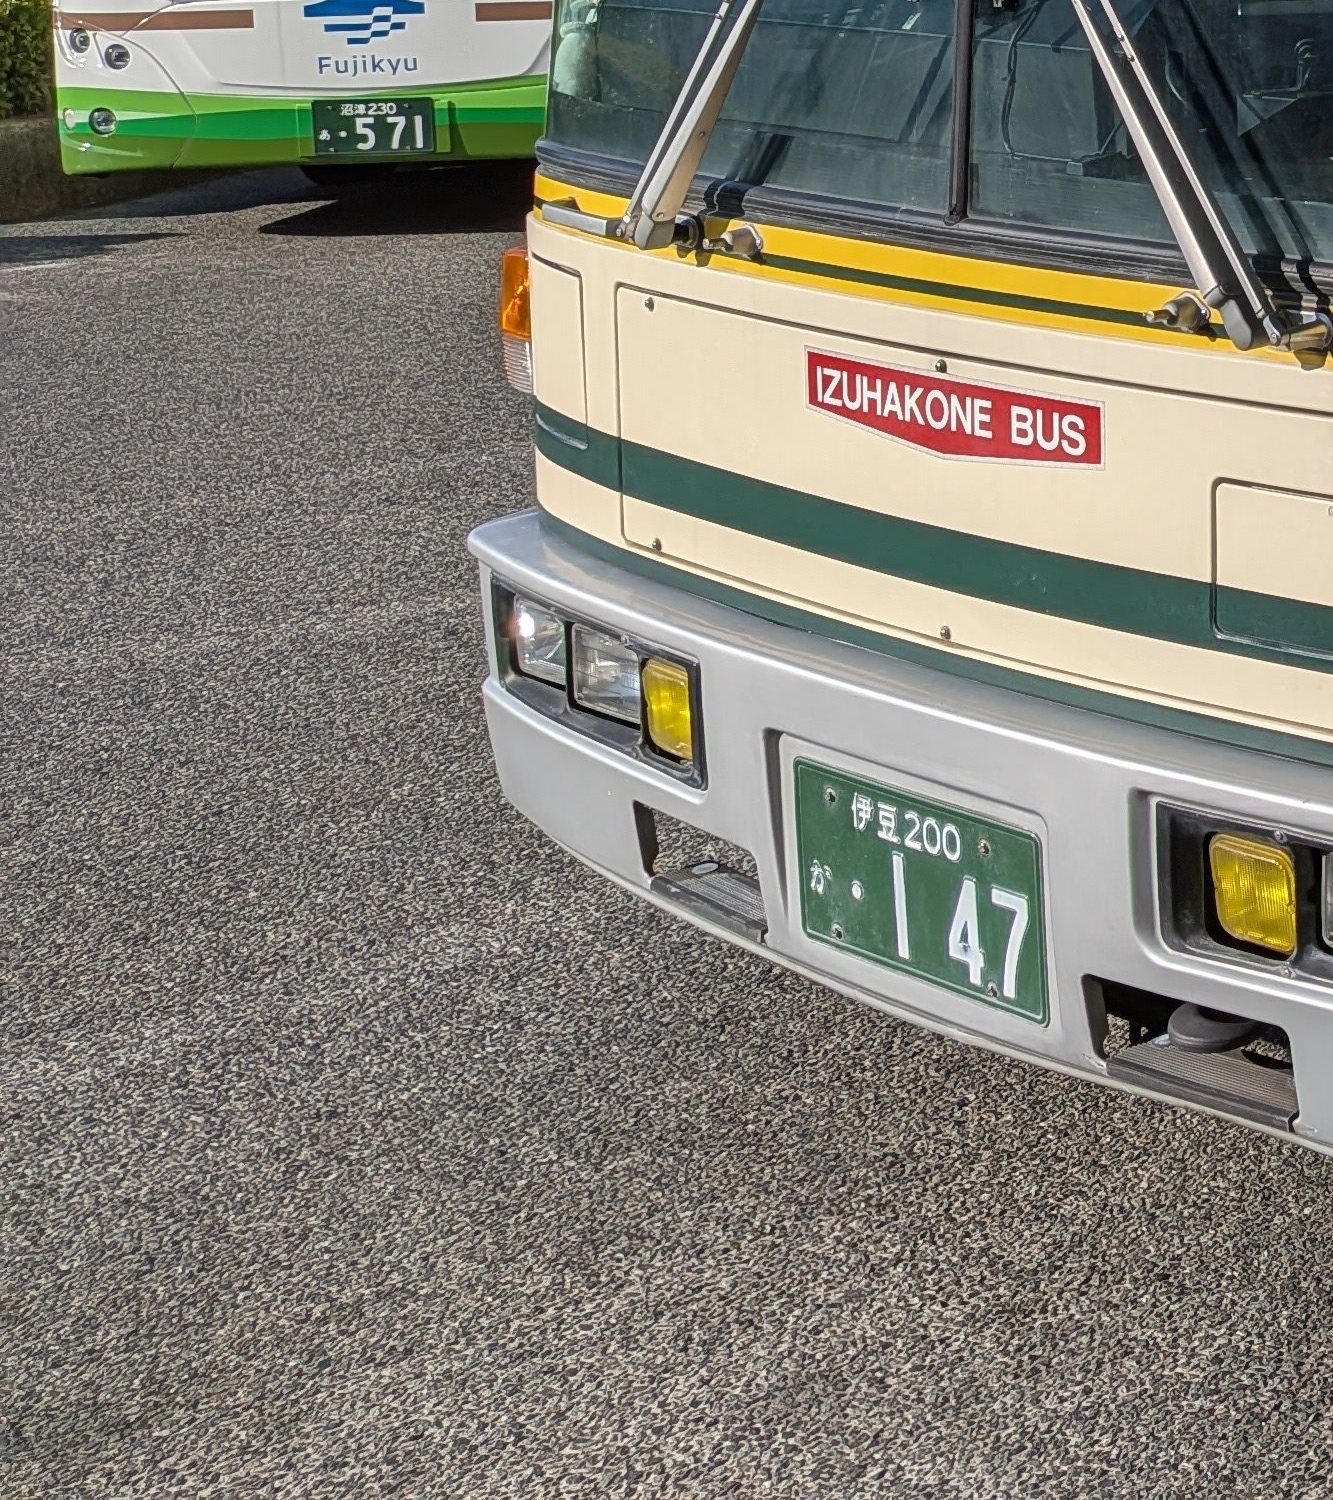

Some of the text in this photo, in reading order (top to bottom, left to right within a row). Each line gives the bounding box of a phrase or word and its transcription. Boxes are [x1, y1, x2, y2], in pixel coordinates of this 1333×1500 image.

[318, 54, 418, 77] Fujikyu
[816, 365, 1086, 456] IZUHAKONE BUS
